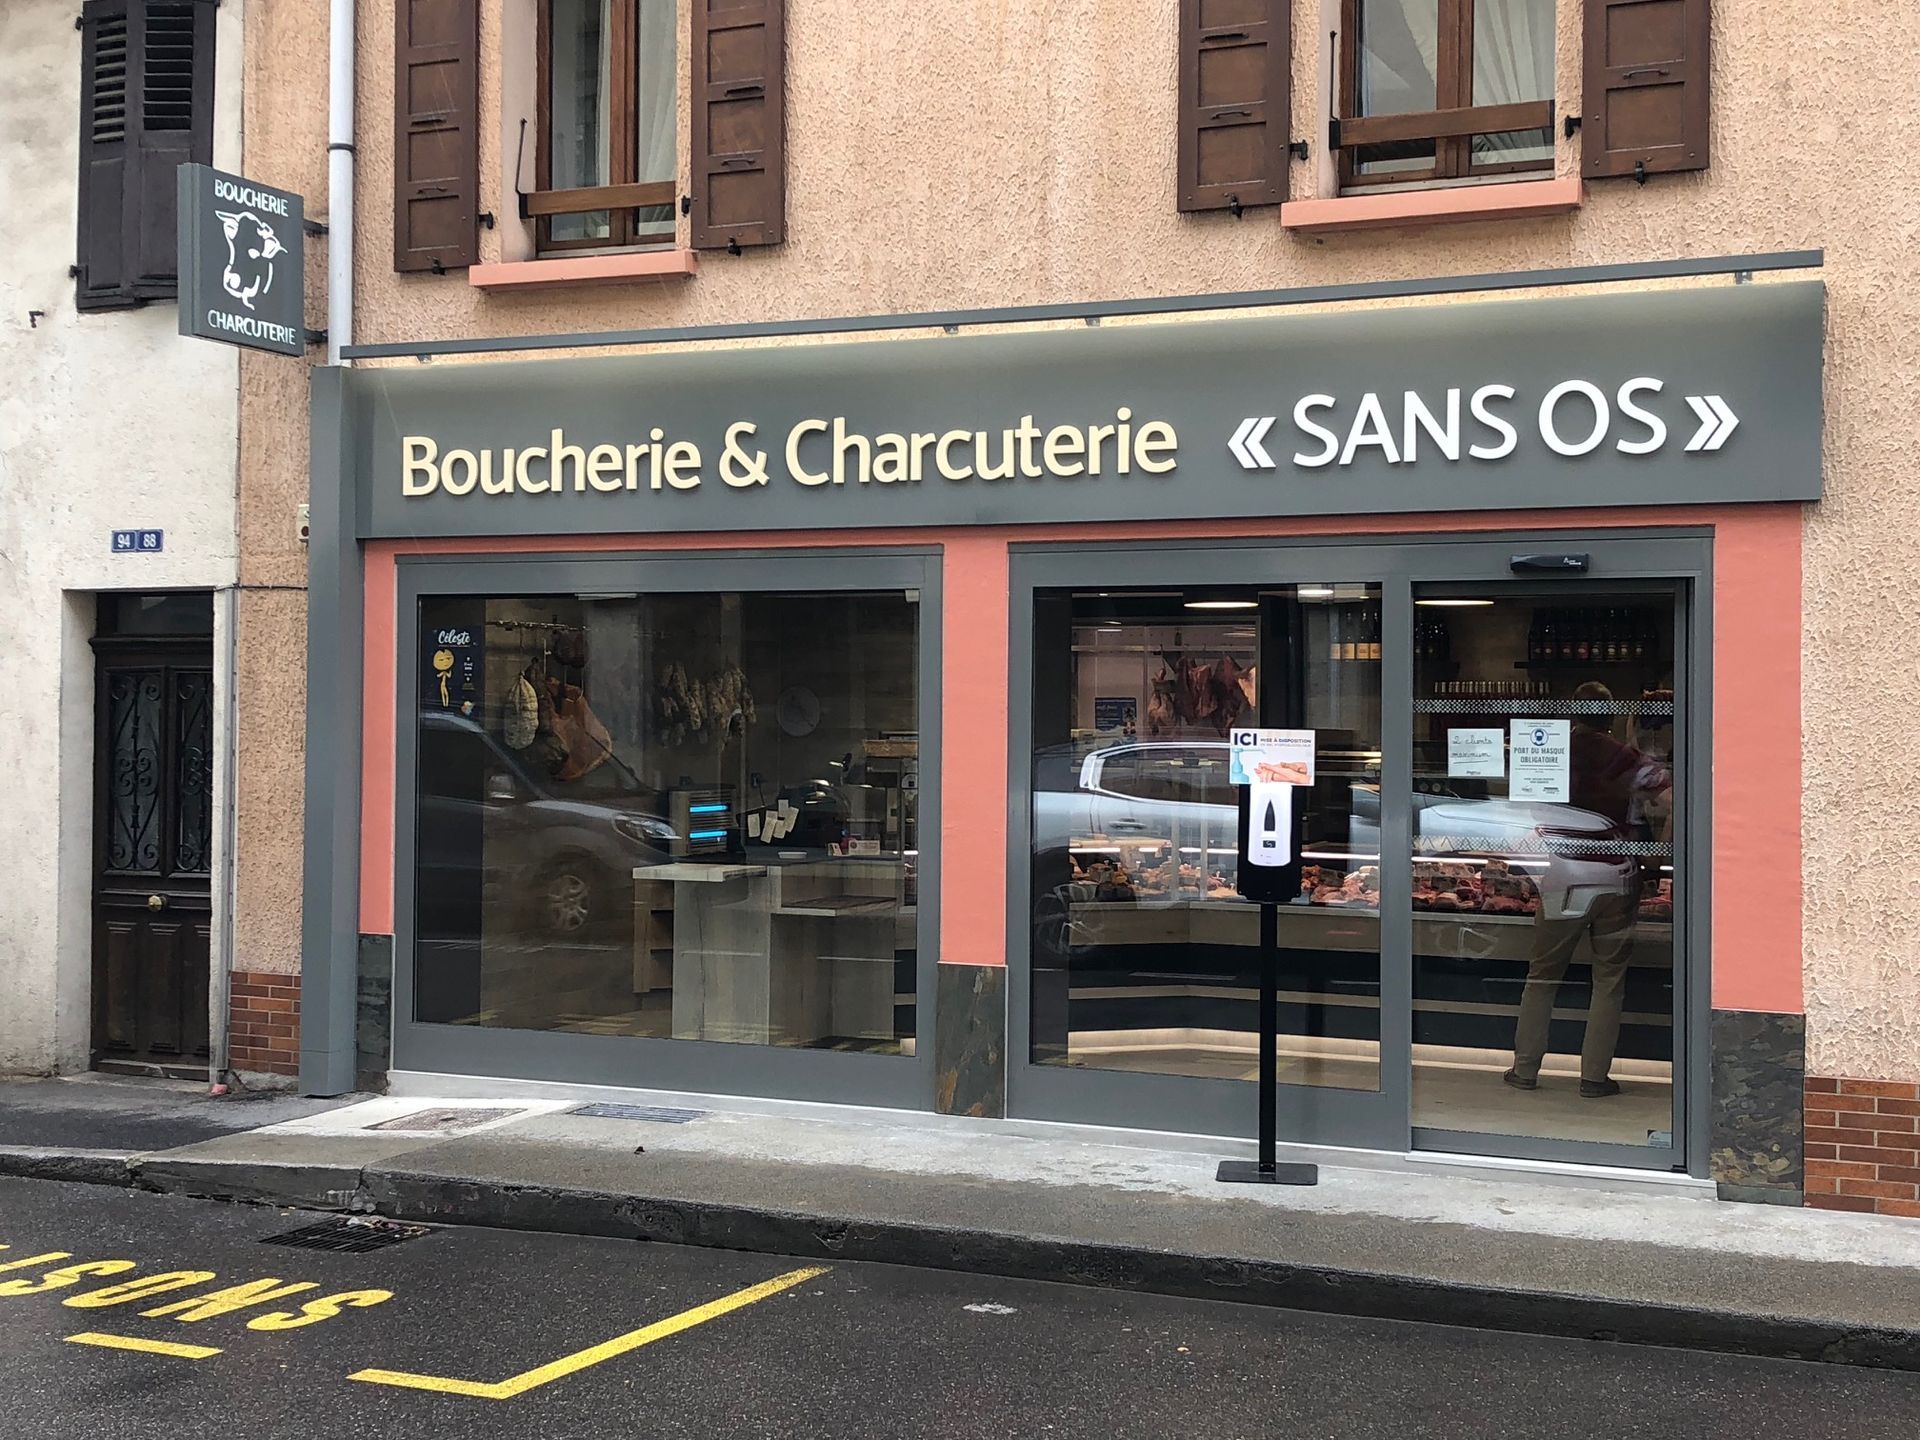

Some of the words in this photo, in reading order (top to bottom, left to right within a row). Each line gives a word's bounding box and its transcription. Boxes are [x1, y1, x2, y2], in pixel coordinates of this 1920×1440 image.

[214, 178, 289, 218] BOUCHERIE
[207, 309, 297, 346] CHARCUTERIE
[402, 427, 702, 497] Boucherie
[718, 420, 770, 488] &
[785, 406, 1179, 487] Charcuterie
[1292, 383, 1519, 468] SANS
[1537, 376, 1668, 457] OS
[117, 533, 131, 549] 94
[143, 533, 157, 548] 88
[1234, 733, 1257, 746] ICI
[1452, 735, 1462, 745] 2
[1464, 734, 1494, 745] clients
[1541, 747, 1565, 755] MASQUE
[1520, 756, 1559, 764] OBLIGATOIRE
[0, 1244, 394, 1331] ISONS
